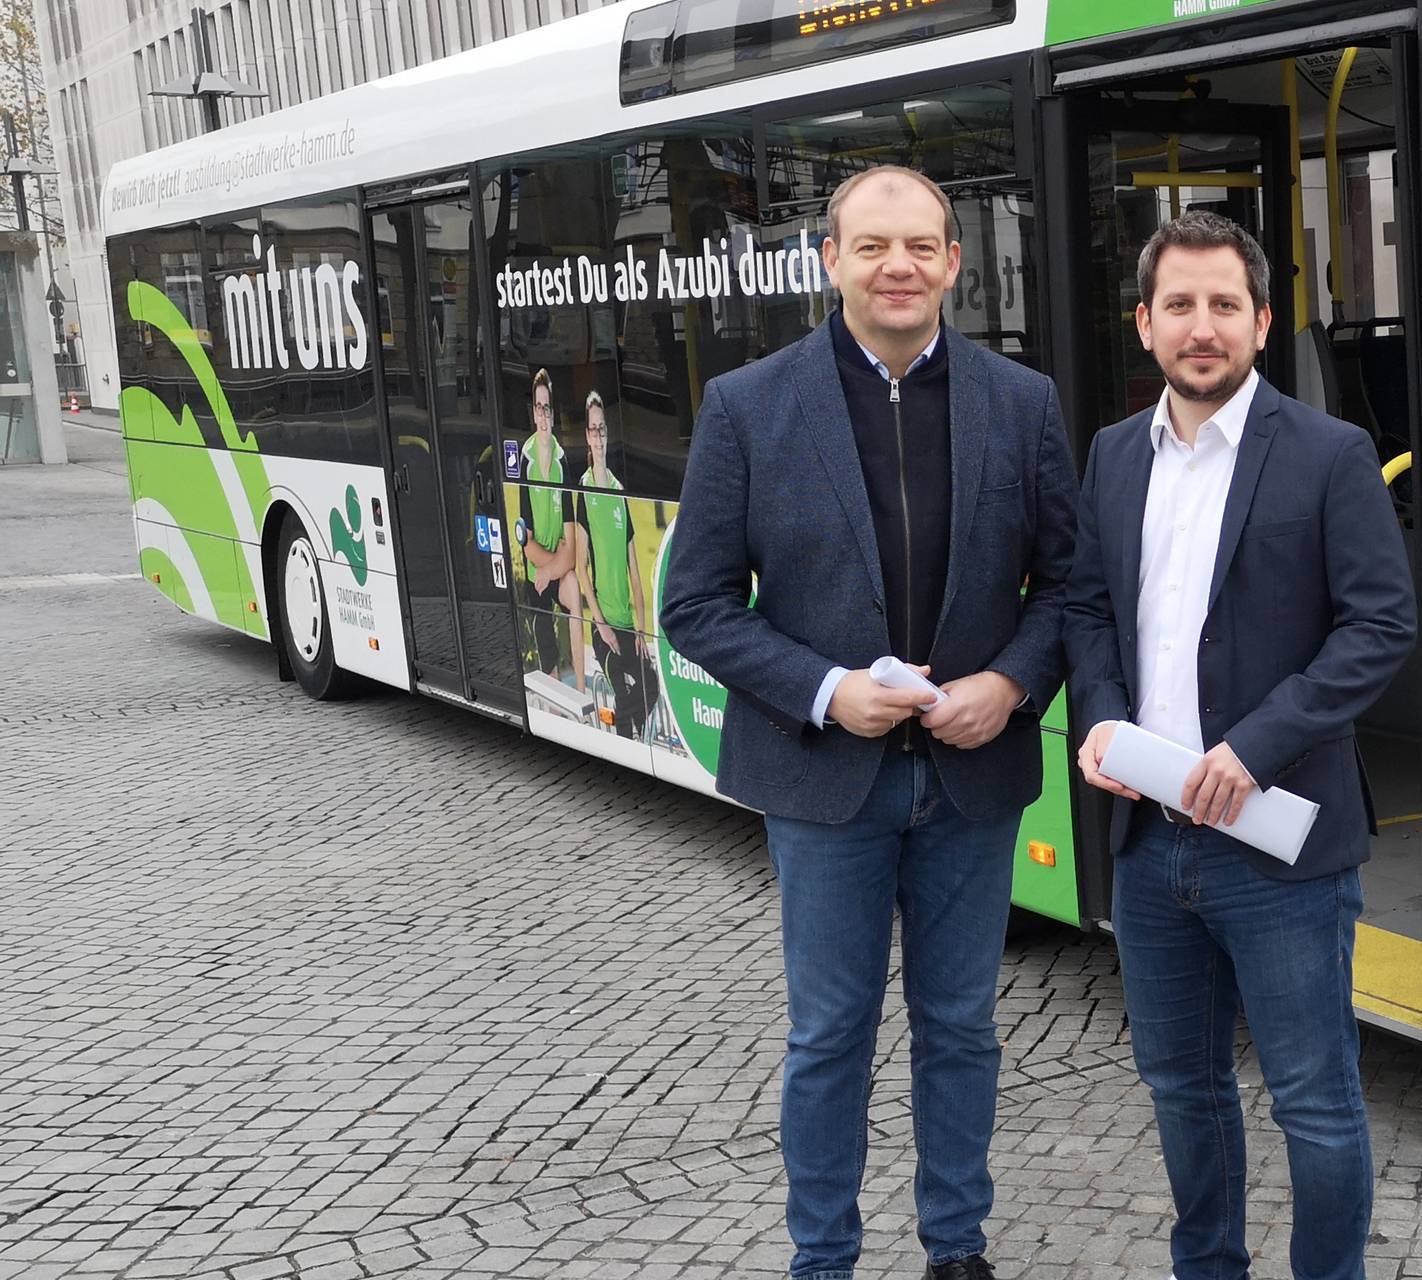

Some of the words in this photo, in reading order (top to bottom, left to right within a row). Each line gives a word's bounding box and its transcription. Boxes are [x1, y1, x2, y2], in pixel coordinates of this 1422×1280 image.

[111, 177, 138, 212] Bewirb
[139, 176, 156, 206] Dich
[157, 169, 181, 208] jetzt!
[184, 119, 356, 192] ausbildung@stadtwerke-hamm.de
[223, 233, 290, 370] mit
[289, 260, 368, 370] uns
[496, 257, 574, 309] startest
[577, 255, 608, 304] Du
[614, 244, 648, 302] als
[657, 237, 730, 300] Azubi
[738, 228, 822, 296] durch
[336, 586, 373, 611] STADTWERKE
[338, 606, 359, 627] HAMM
